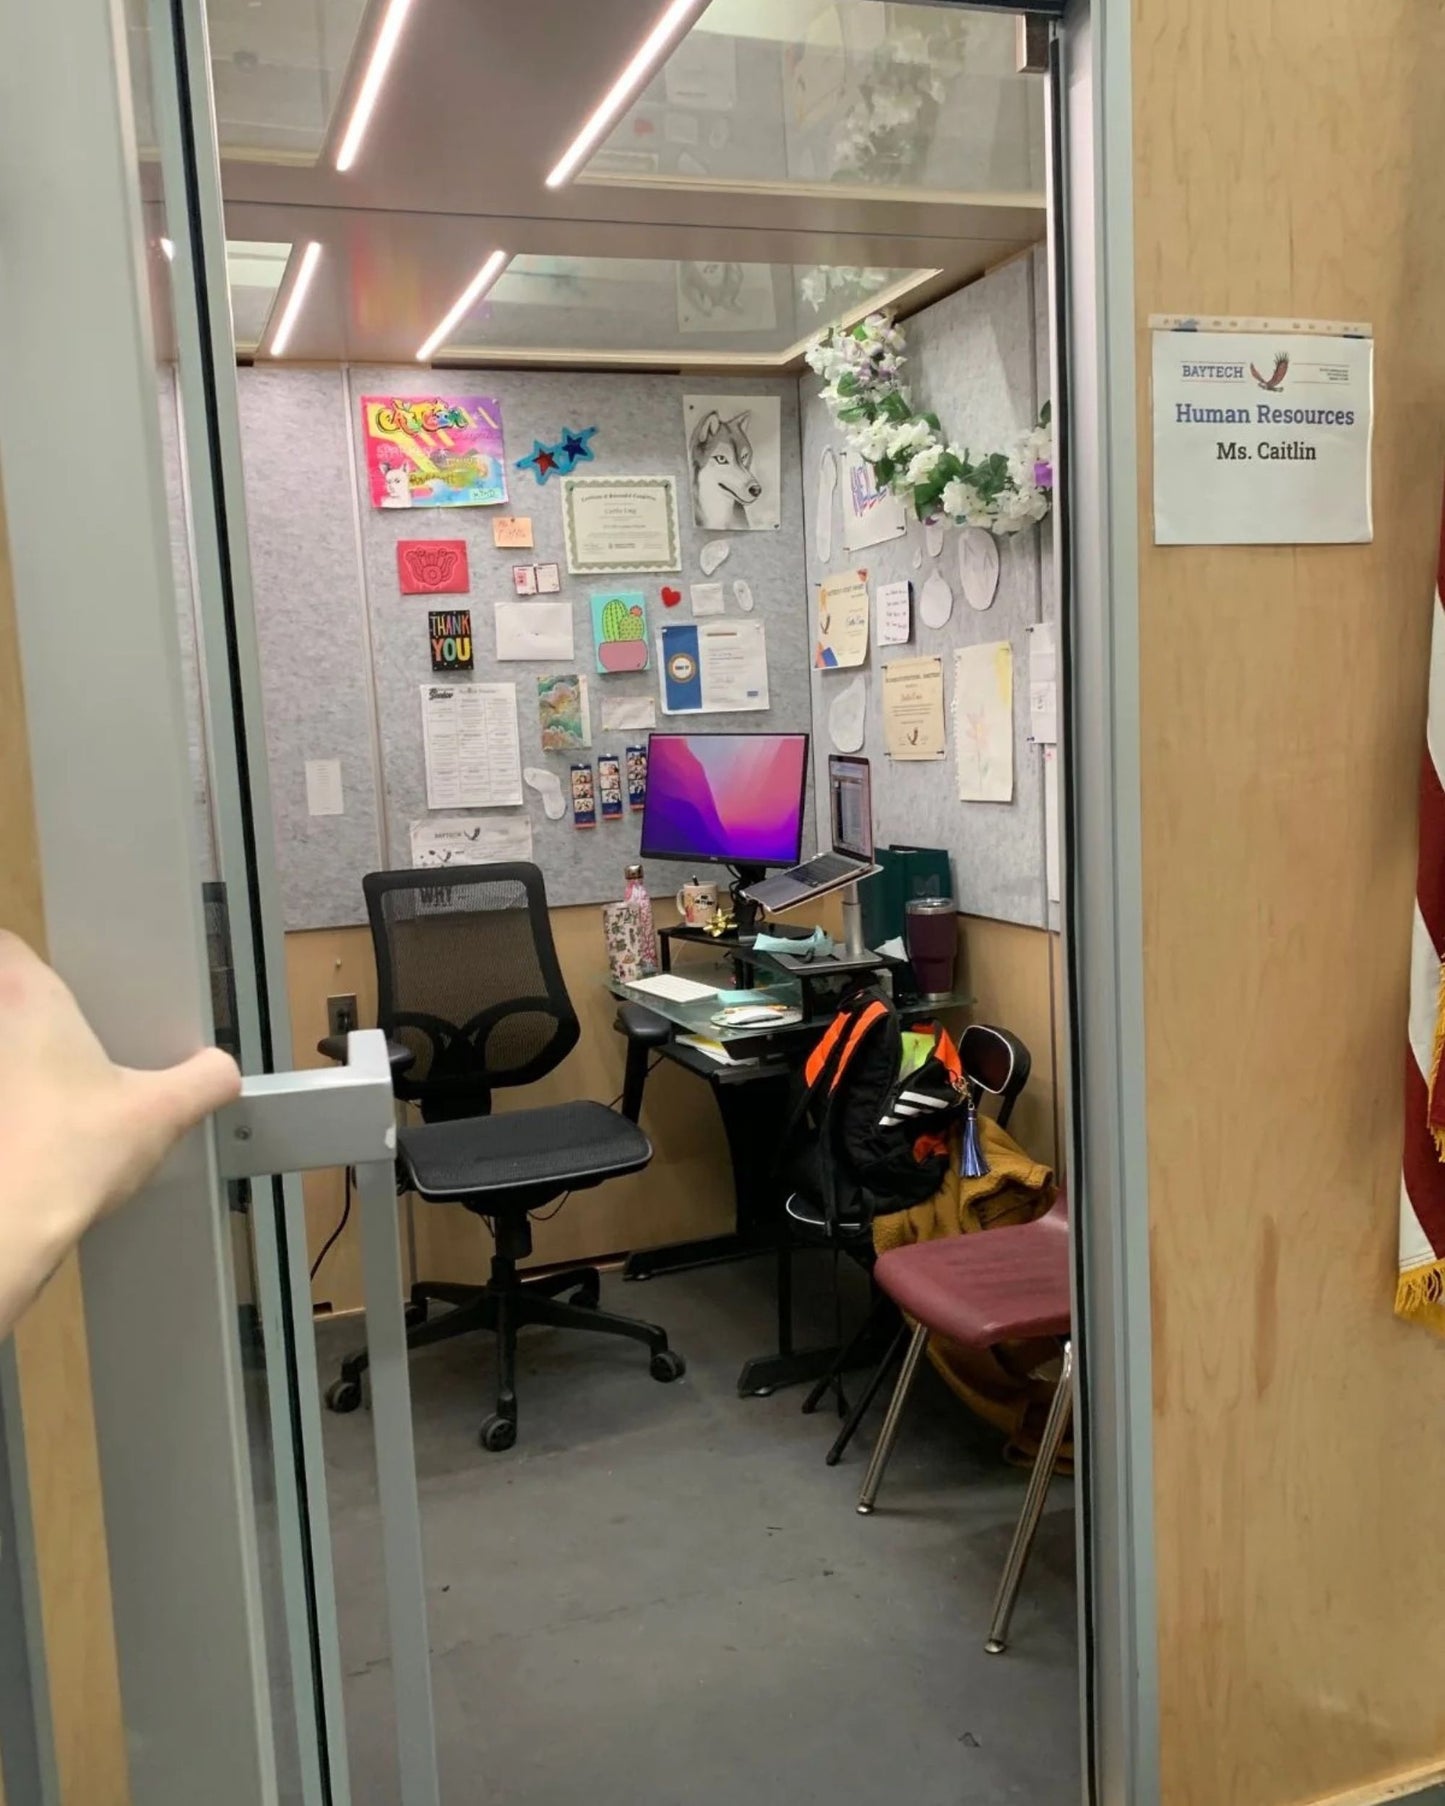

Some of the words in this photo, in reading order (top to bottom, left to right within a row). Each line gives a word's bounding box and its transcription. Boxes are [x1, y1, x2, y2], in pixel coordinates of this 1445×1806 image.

[1181, 364, 1244, 379] BAYTECH
[1175, 403, 1251, 424] Human
[1256, 404, 1355, 425] Resources
[1216, 442, 1252, 460] Ms.
[1257, 441, 1317, 460] Caitlin
[429, 614, 470, 636] THANK
[431, 637, 471, 662] YOU
